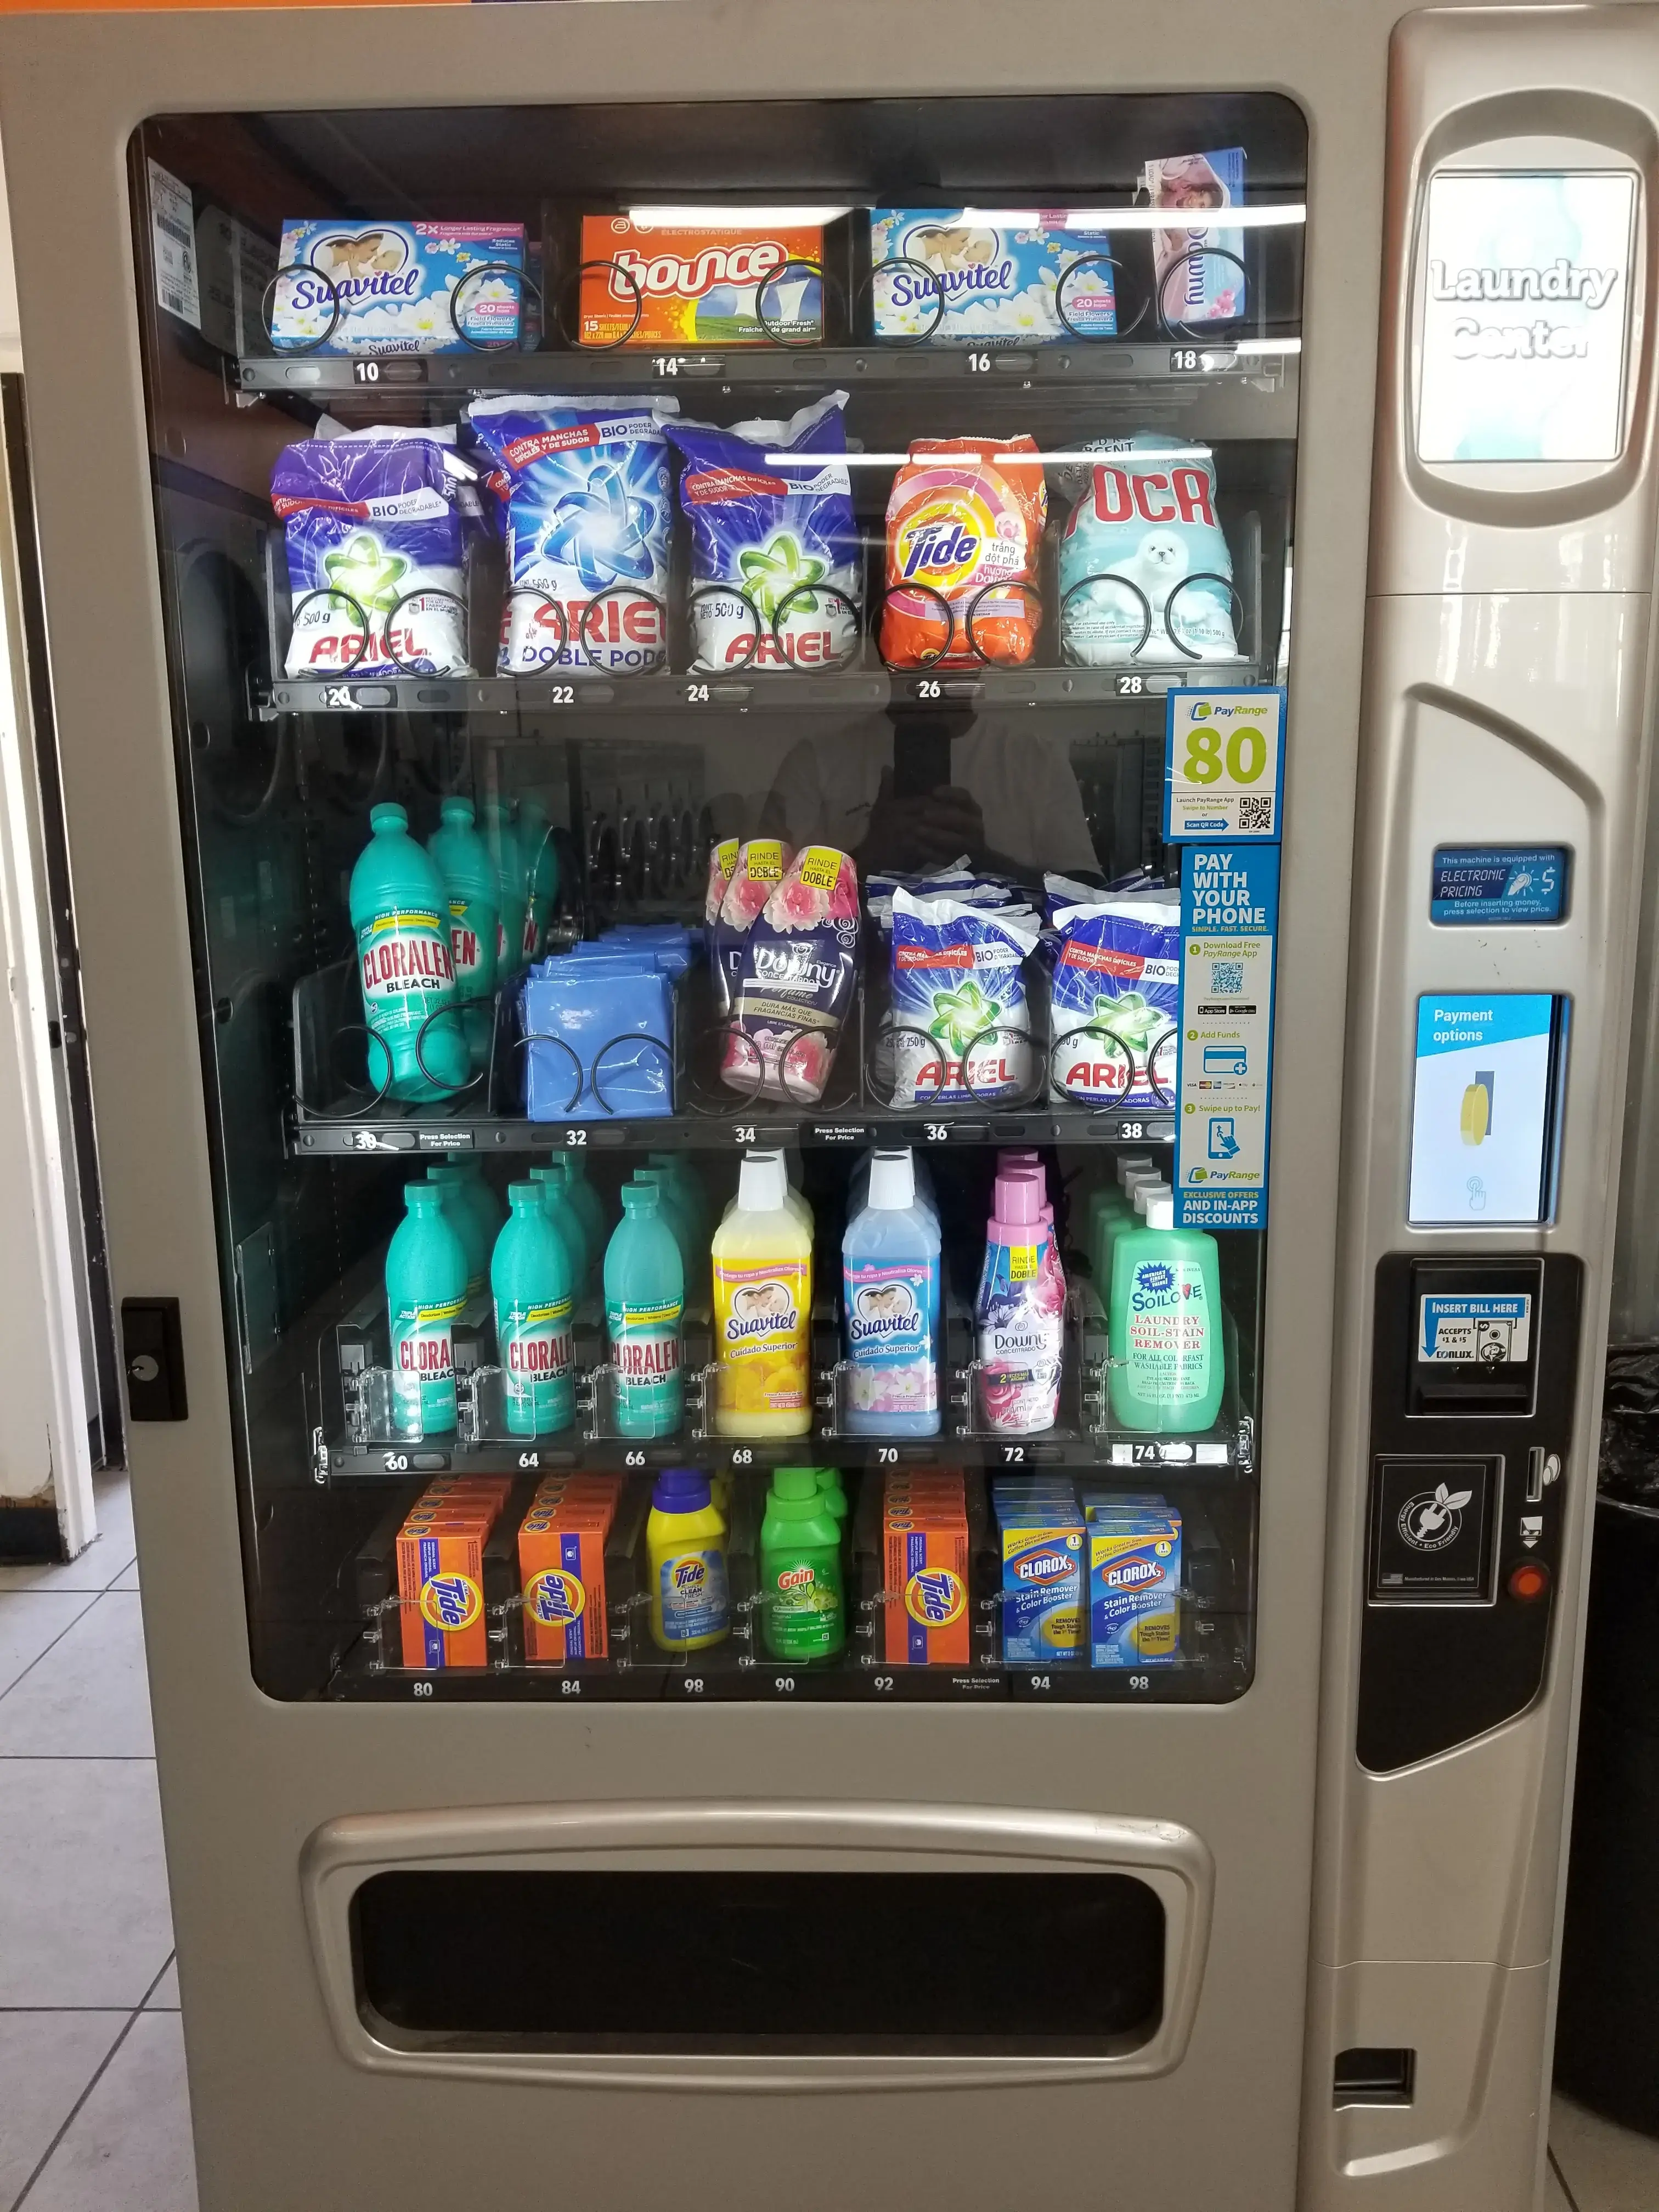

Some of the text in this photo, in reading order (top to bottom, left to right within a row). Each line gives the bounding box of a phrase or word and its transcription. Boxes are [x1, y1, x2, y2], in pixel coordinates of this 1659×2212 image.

[612, 241, 781, 297] bounce
[1184, 227, 1209, 307] Downy
[291, 268, 419, 309] Suavitel
[891, 260, 1012, 307] Suavitel
[1430, 259, 1618, 309] Laundry
[479, 304, 495, 313] 20
[1077, 299, 1092, 307] 20
[584, 320, 599, 331] 15
[1451, 317, 1591, 360] Center
[655, 357, 678, 376] 14
[968, 353, 991, 372] 16
[1174, 351, 1197, 369] 18
[356, 362, 379, 382] 10
[601, 425, 627, 437] BIO
[510, 429, 588, 456] CONTRA MANCHAS
[561, 437, 590, 447] SUDOR
[790, 483, 814, 492] BIO
[372, 504, 398, 516] BIO
[902, 524, 978, 579] Tide
[303, 611, 320, 626] 500
[309, 628, 428, 663] ARIEL
[725, 631, 841, 664] ARIEL
[522, 646, 602, 666] DOBLE
[918, 680, 940, 698] 26
[1120, 676, 1142, 694] 28
[552, 686, 574, 703] 22
[687, 685, 709, 702] 24
[1214, 706, 1268, 716] PayRange
[1183, 726, 1267, 784] 80
[808, 858, 838, 870] RINDE
[1194, 854, 1233, 870] PAY
[1193, 872, 1248, 889] WITH
[1441, 869, 1506, 882] ELECTRONIC
[1192, 890, 1250, 906] YOUR
[1440, 885, 1482, 898] PRICING
[1193, 907, 1266, 924] PHONE
[976, 950, 994, 962] BIO
[363, 940, 454, 990] CLORALEN
[758, 949, 836, 988] Downy
[1146, 964, 1166, 975] BIO
[386, 978, 440, 994] BLEACH
[754, 1007, 795, 1018] FRAGANCIAS
[1434, 1009, 1493, 1025] Payment
[907, 1037, 919, 1047] 250
[1433, 1029, 1483, 1043] options
[916, 1059, 1015, 1086] ARIEL
[1066, 1062, 1169, 1088] ARIEL
[1244, 1104, 1260, 1113] Pay!
[566, 1130, 587, 1146] 32
[735, 1127, 755, 1143] 34
[927, 1125, 947, 1141] 36
[1121, 1123, 1142, 1139] 38
[1210, 1171, 1260, 1181] PayRange
[1184, 1200, 1257, 1211] AND IN-APP
[1183, 1213, 1259, 1224] DISCOUNTS
[639, 1300, 678, 1312] PERFORMANCE
[1432, 1302, 1517, 1313] INSERT BILL HERE
[727, 1310, 797, 1339] Suavitel
[851, 1312, 919, 1340] Suavitel
[1135, 1314, 1199, 1325] LAUNDRY
[1130, 1326, 1204, 1336] SOIL-STAIN
[995, 1333, 1047, 1350] Downy
[611, 1338, 679, 1375] CLORALEN
[730, 1346, 761, 1358] Cuidado
[854, 1347, 884, 1358] Cuidado
[996, 1347, 1036, 1355] CONCENTRADO
[626, 1374, 666, 1385] BLEACH
[519, 1453, 539, 1467] 64
[625, 1451, 645, 1465] 66
[732, 1449, 753, 1464] 68
[878, 1448, 898, 1463] 70
[1005, 1448, 1024, 1462] 72
[1135, 1446, 1155, 1459] 74
[388, 1455, 408, 1470] 60
[1400, 1502, 1415, 1522] Energy
[1401, 1523, 1418, 1545] Efficient
[1438, 1526, 1459, 1547] Friendly
[1007, 1539, 1024, 1549] Works
[675, 1564, 706, 1588] Tide
[778, 1568, 815, 1590] Gain
[429, 1578, 468, 1626] Tide
[538, 1574, 577, 1621] Tide
[915, 1572, 952, 1622] Tide
[1015, 1585, 1077, 1603] Stain Remover
[1021, 1593, 1073, 1610] Color Booster
[1104, 1593, 1166, 1610] Stain Remover
[1109, 1606, 1130, 1617] Color
[413, 1683, 433, 1696] 80
[562, 1680, 581, 1694] 84
[775, 1678, 795, 1691] 90
[874, 1677, 894, 1691] 92
[1031, 1676, 1051, 1690] 94
[1130, 1676, 1149, 1690] 98
